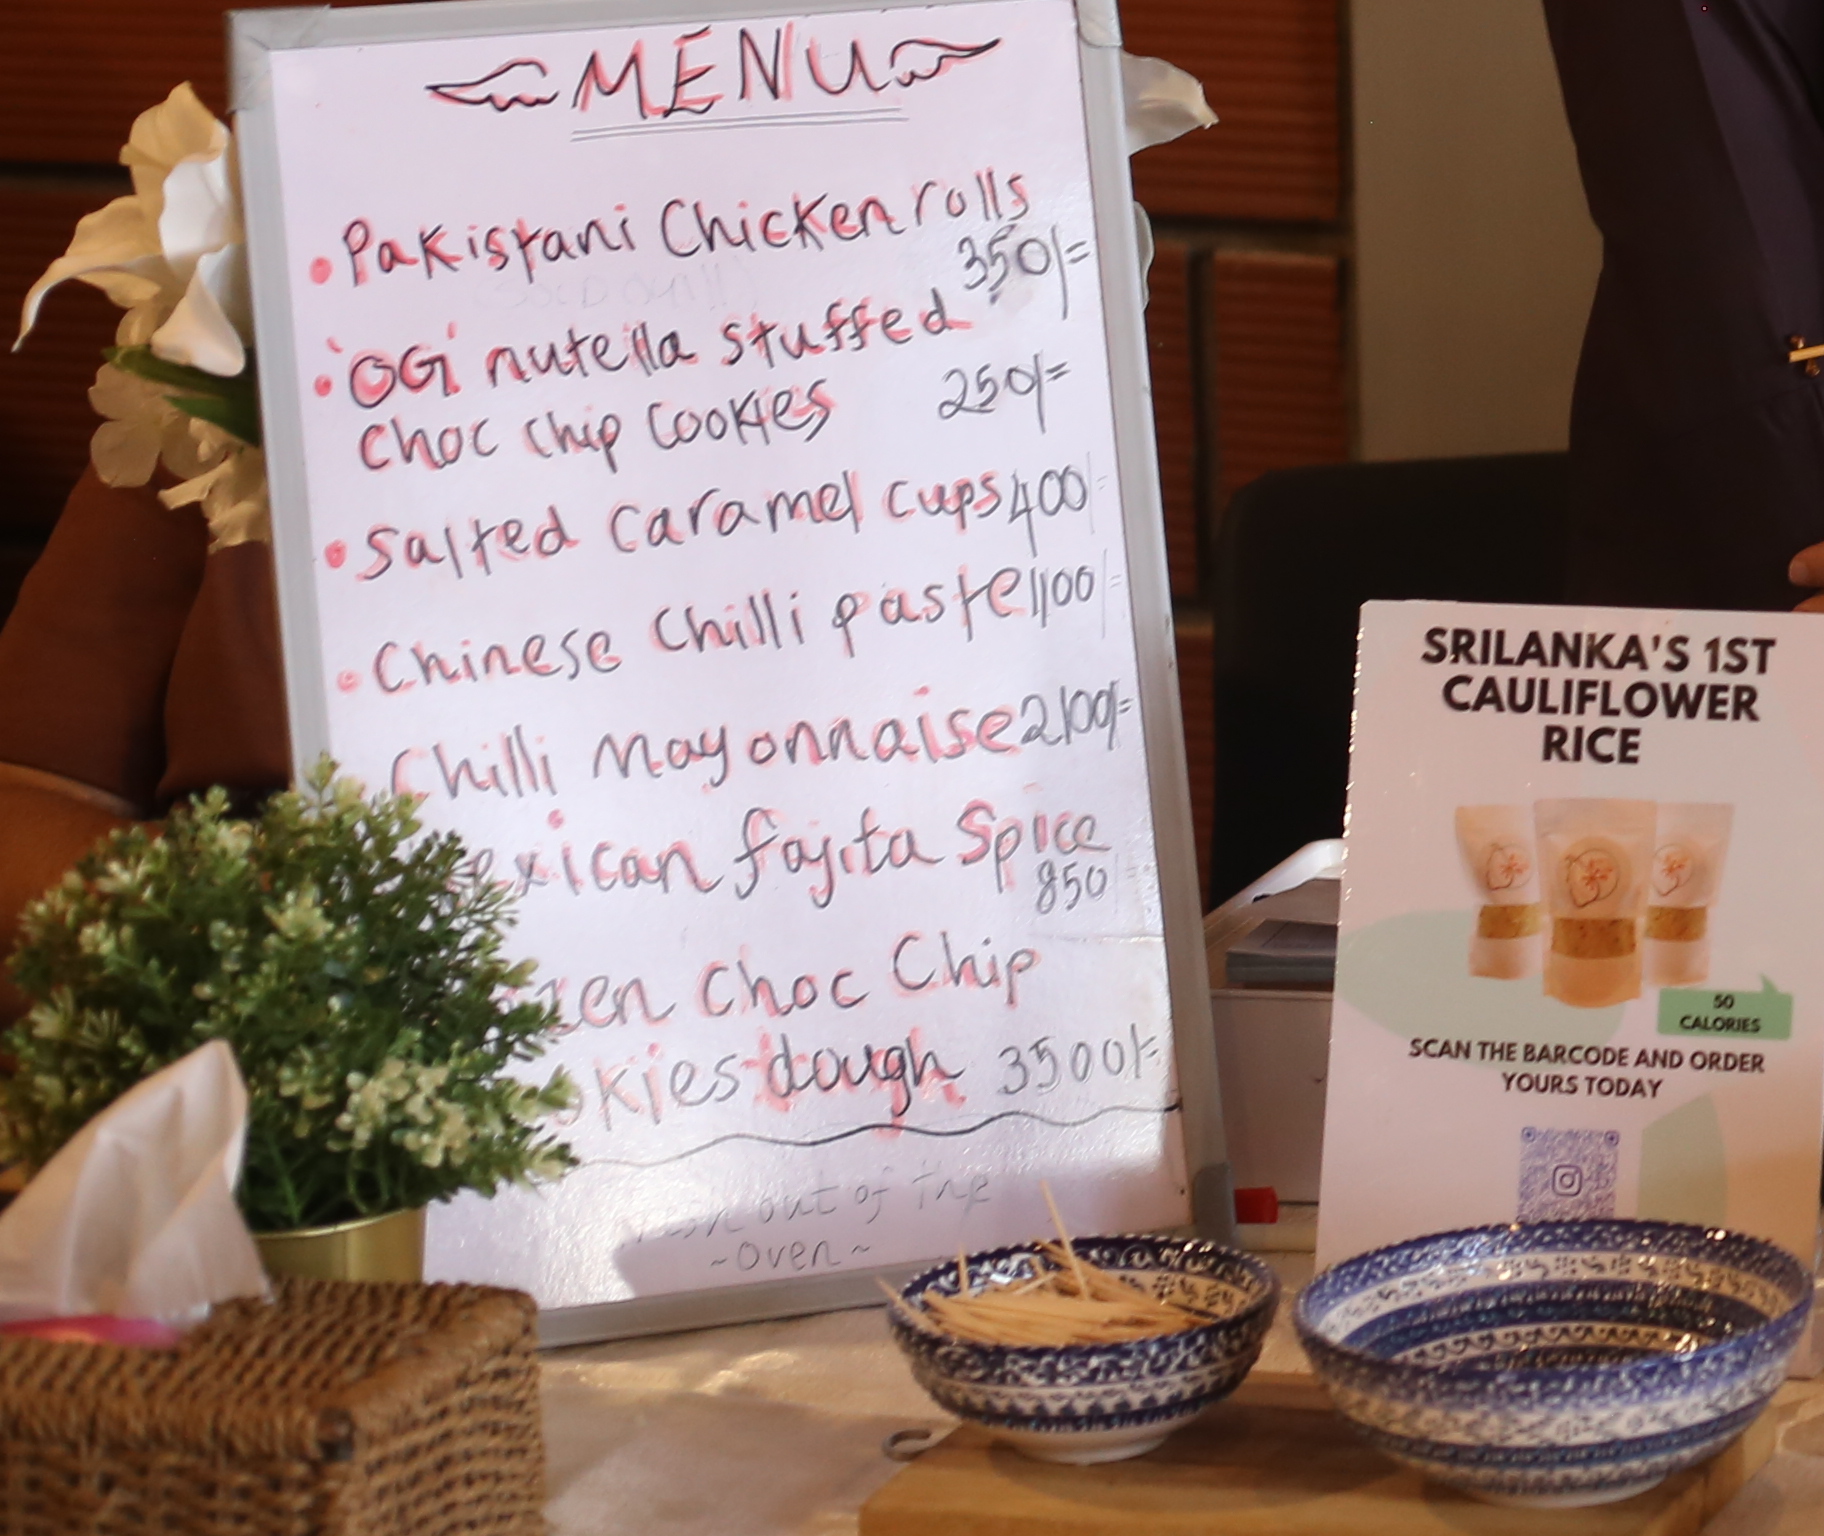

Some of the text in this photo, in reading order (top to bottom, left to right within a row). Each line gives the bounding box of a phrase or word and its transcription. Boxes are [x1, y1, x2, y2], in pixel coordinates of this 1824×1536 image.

[571, 24, 886, 118] MENU
[661, 193, 907, 257] Chicken
[914, 168, 1029, 226] rolls
[486, 321, 699, 388] nutella
[720, 287, 972, 368] stuffed
[832, 564, 1027, 658] paste
[1422, 626, 1777, 676] SRILANKA'S 1ST
[1442, 675, 1760, 722] CAULIFLOWER
[1542, 725, 1641, 765] RICE
[1679, 1015, 1762, 1034] CALORIES
[1713, 994, 1735, 1011] 50
[1409, 1037, 1765, 1073] SCAN THE BARCODE AND ORDER
[1502, 1071, 1663, 1099] YOURS TODAY
